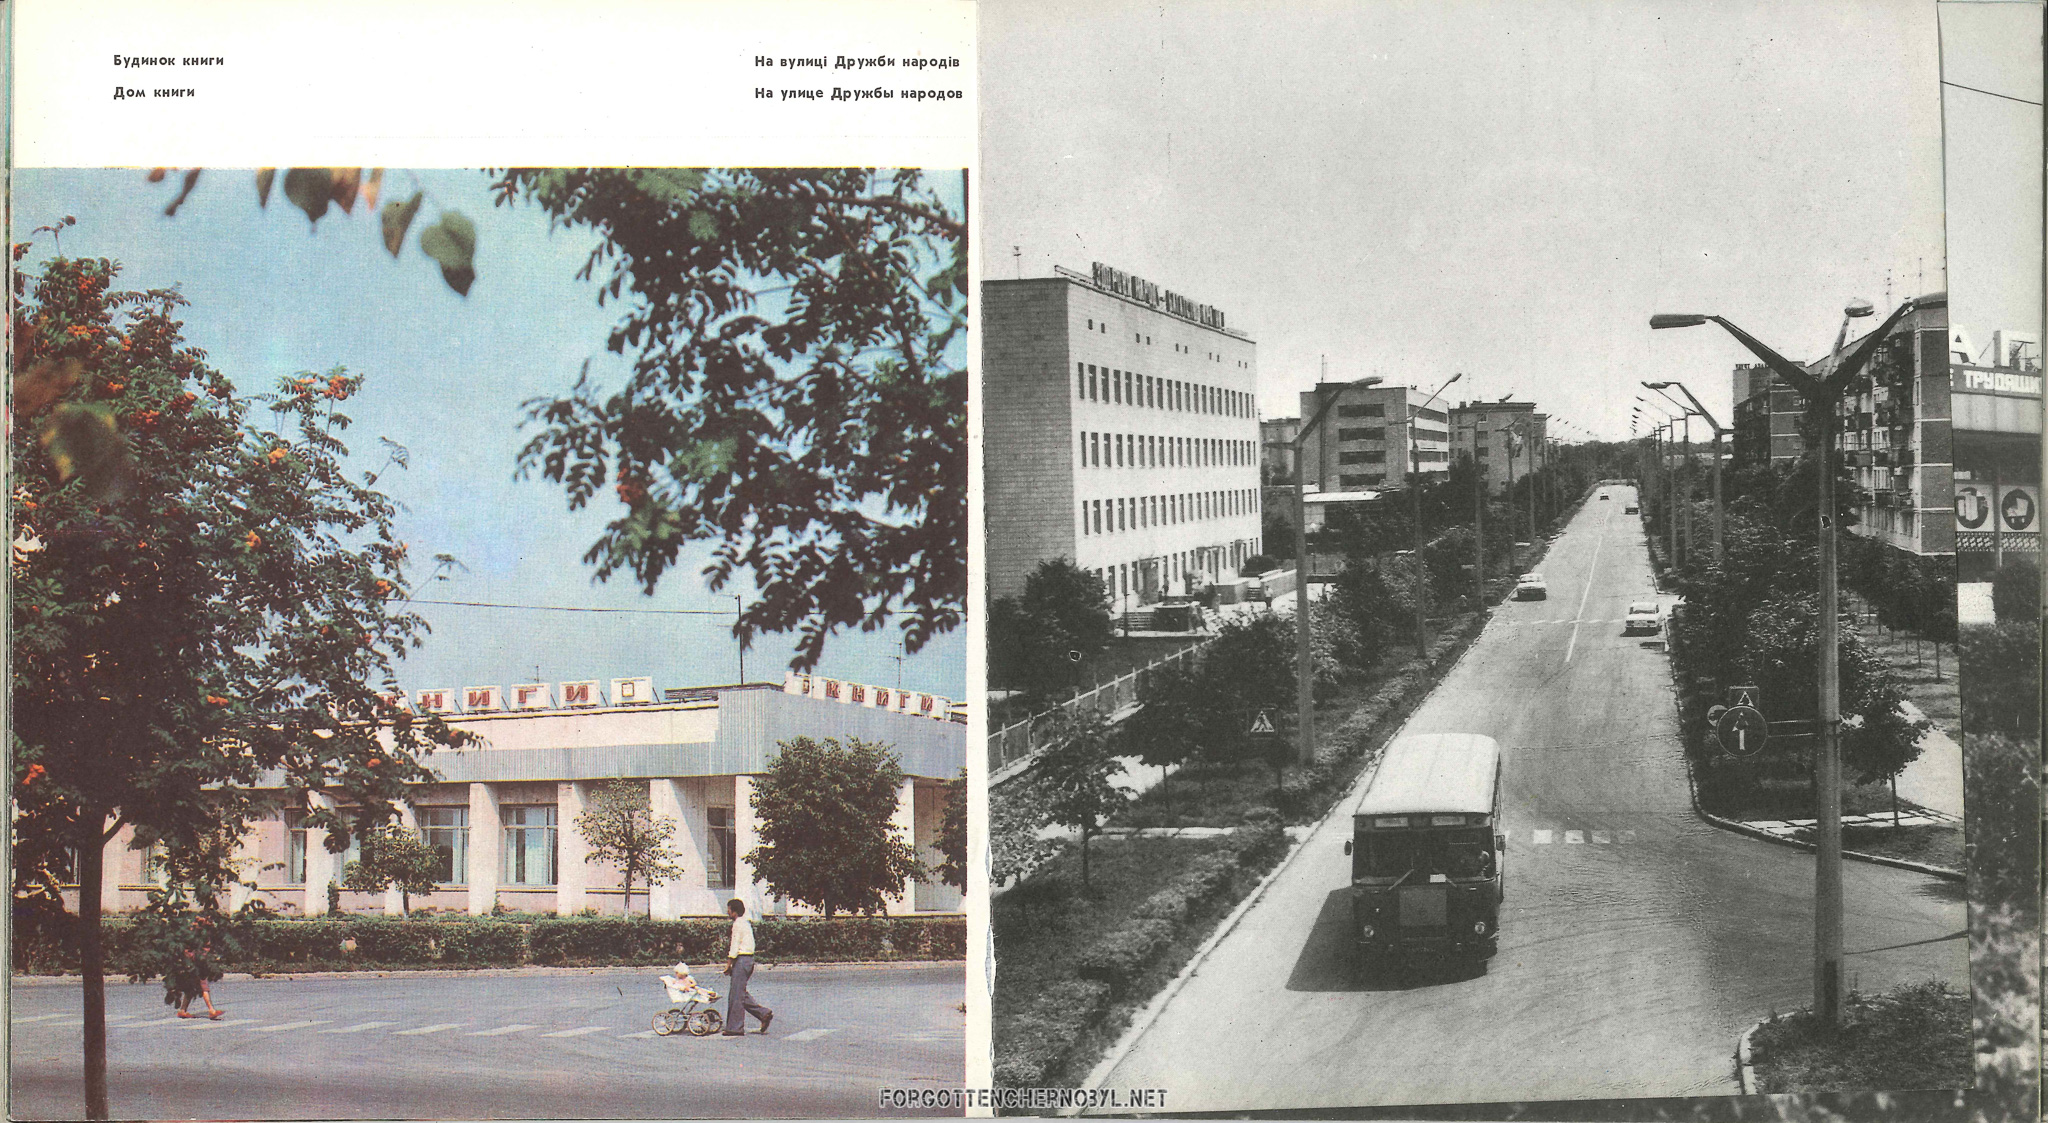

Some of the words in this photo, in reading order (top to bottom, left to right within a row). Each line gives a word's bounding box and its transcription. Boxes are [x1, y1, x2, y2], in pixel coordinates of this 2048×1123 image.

[113, 54, 176, 68] Будинок
[182, 56, 224, 66] книги
[755, 55, 773, 67] На
[780, 55, 827, 70] вулиці
[834, 55, 896, 70] Дружби
[902, 56, 960, 71] народів
[113, 86, 146, 100] Дом
[153, 88, 195, 98] книги
[755, 87, 773, 99] На
[780, 89, 824, 102] улице
[830, 86, 894, 102] Дружбы
[901, 89, 963, 102] народов
[826, 681, 933, 712] КНИГИ
